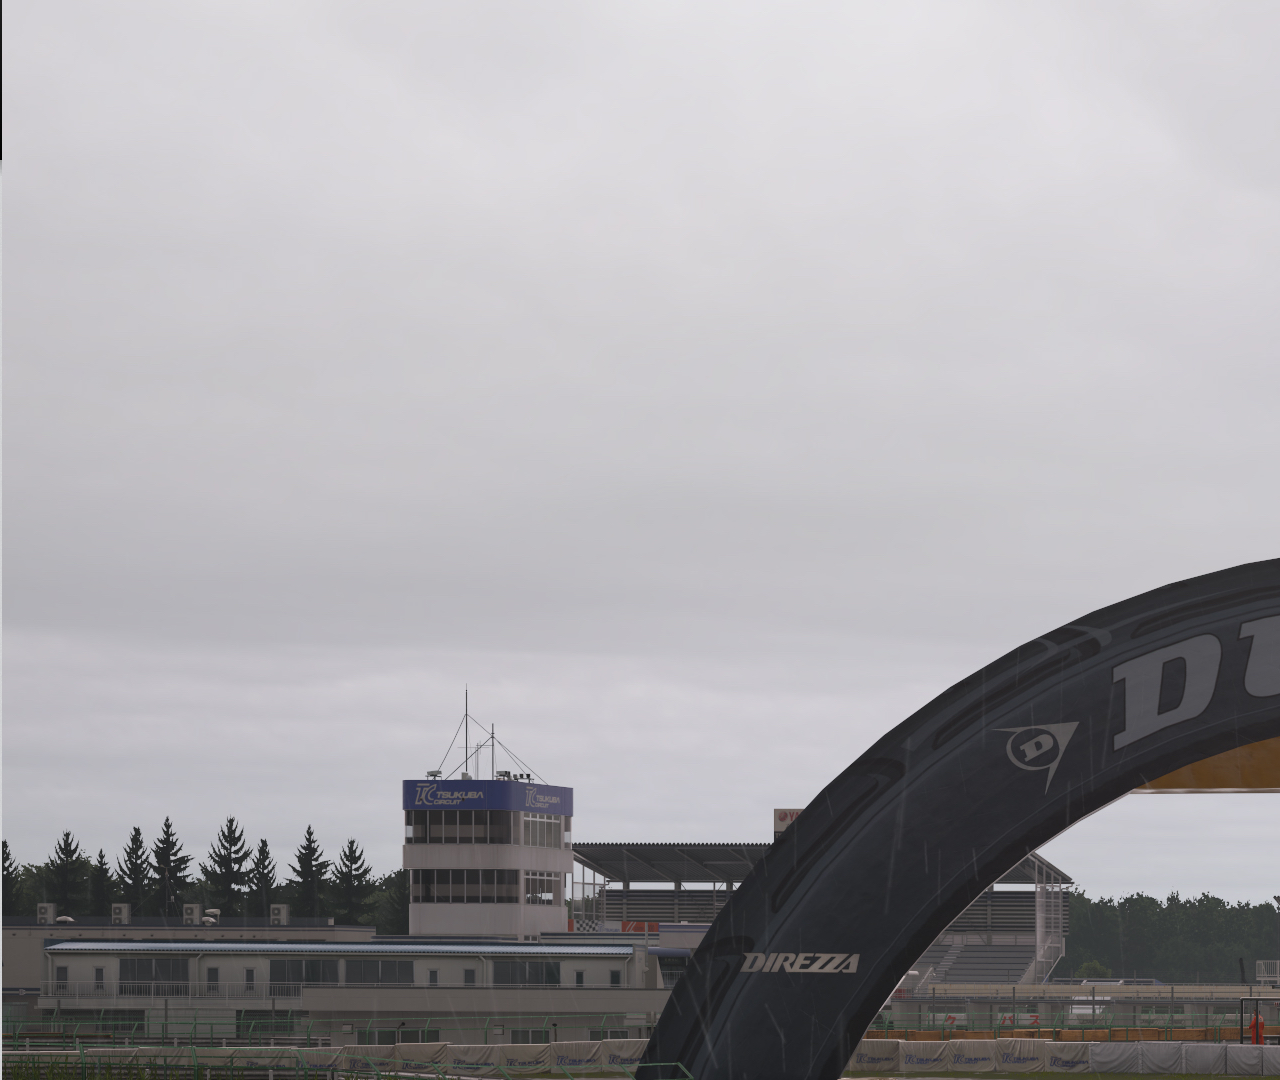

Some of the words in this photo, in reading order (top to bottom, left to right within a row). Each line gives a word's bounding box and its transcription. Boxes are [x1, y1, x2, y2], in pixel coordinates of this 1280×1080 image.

[436, 791, 484, 799] TSUKUBA
[536, 795, 561, 804] TSUKUBA
[740, 952, 860, 973] DIREZZA
